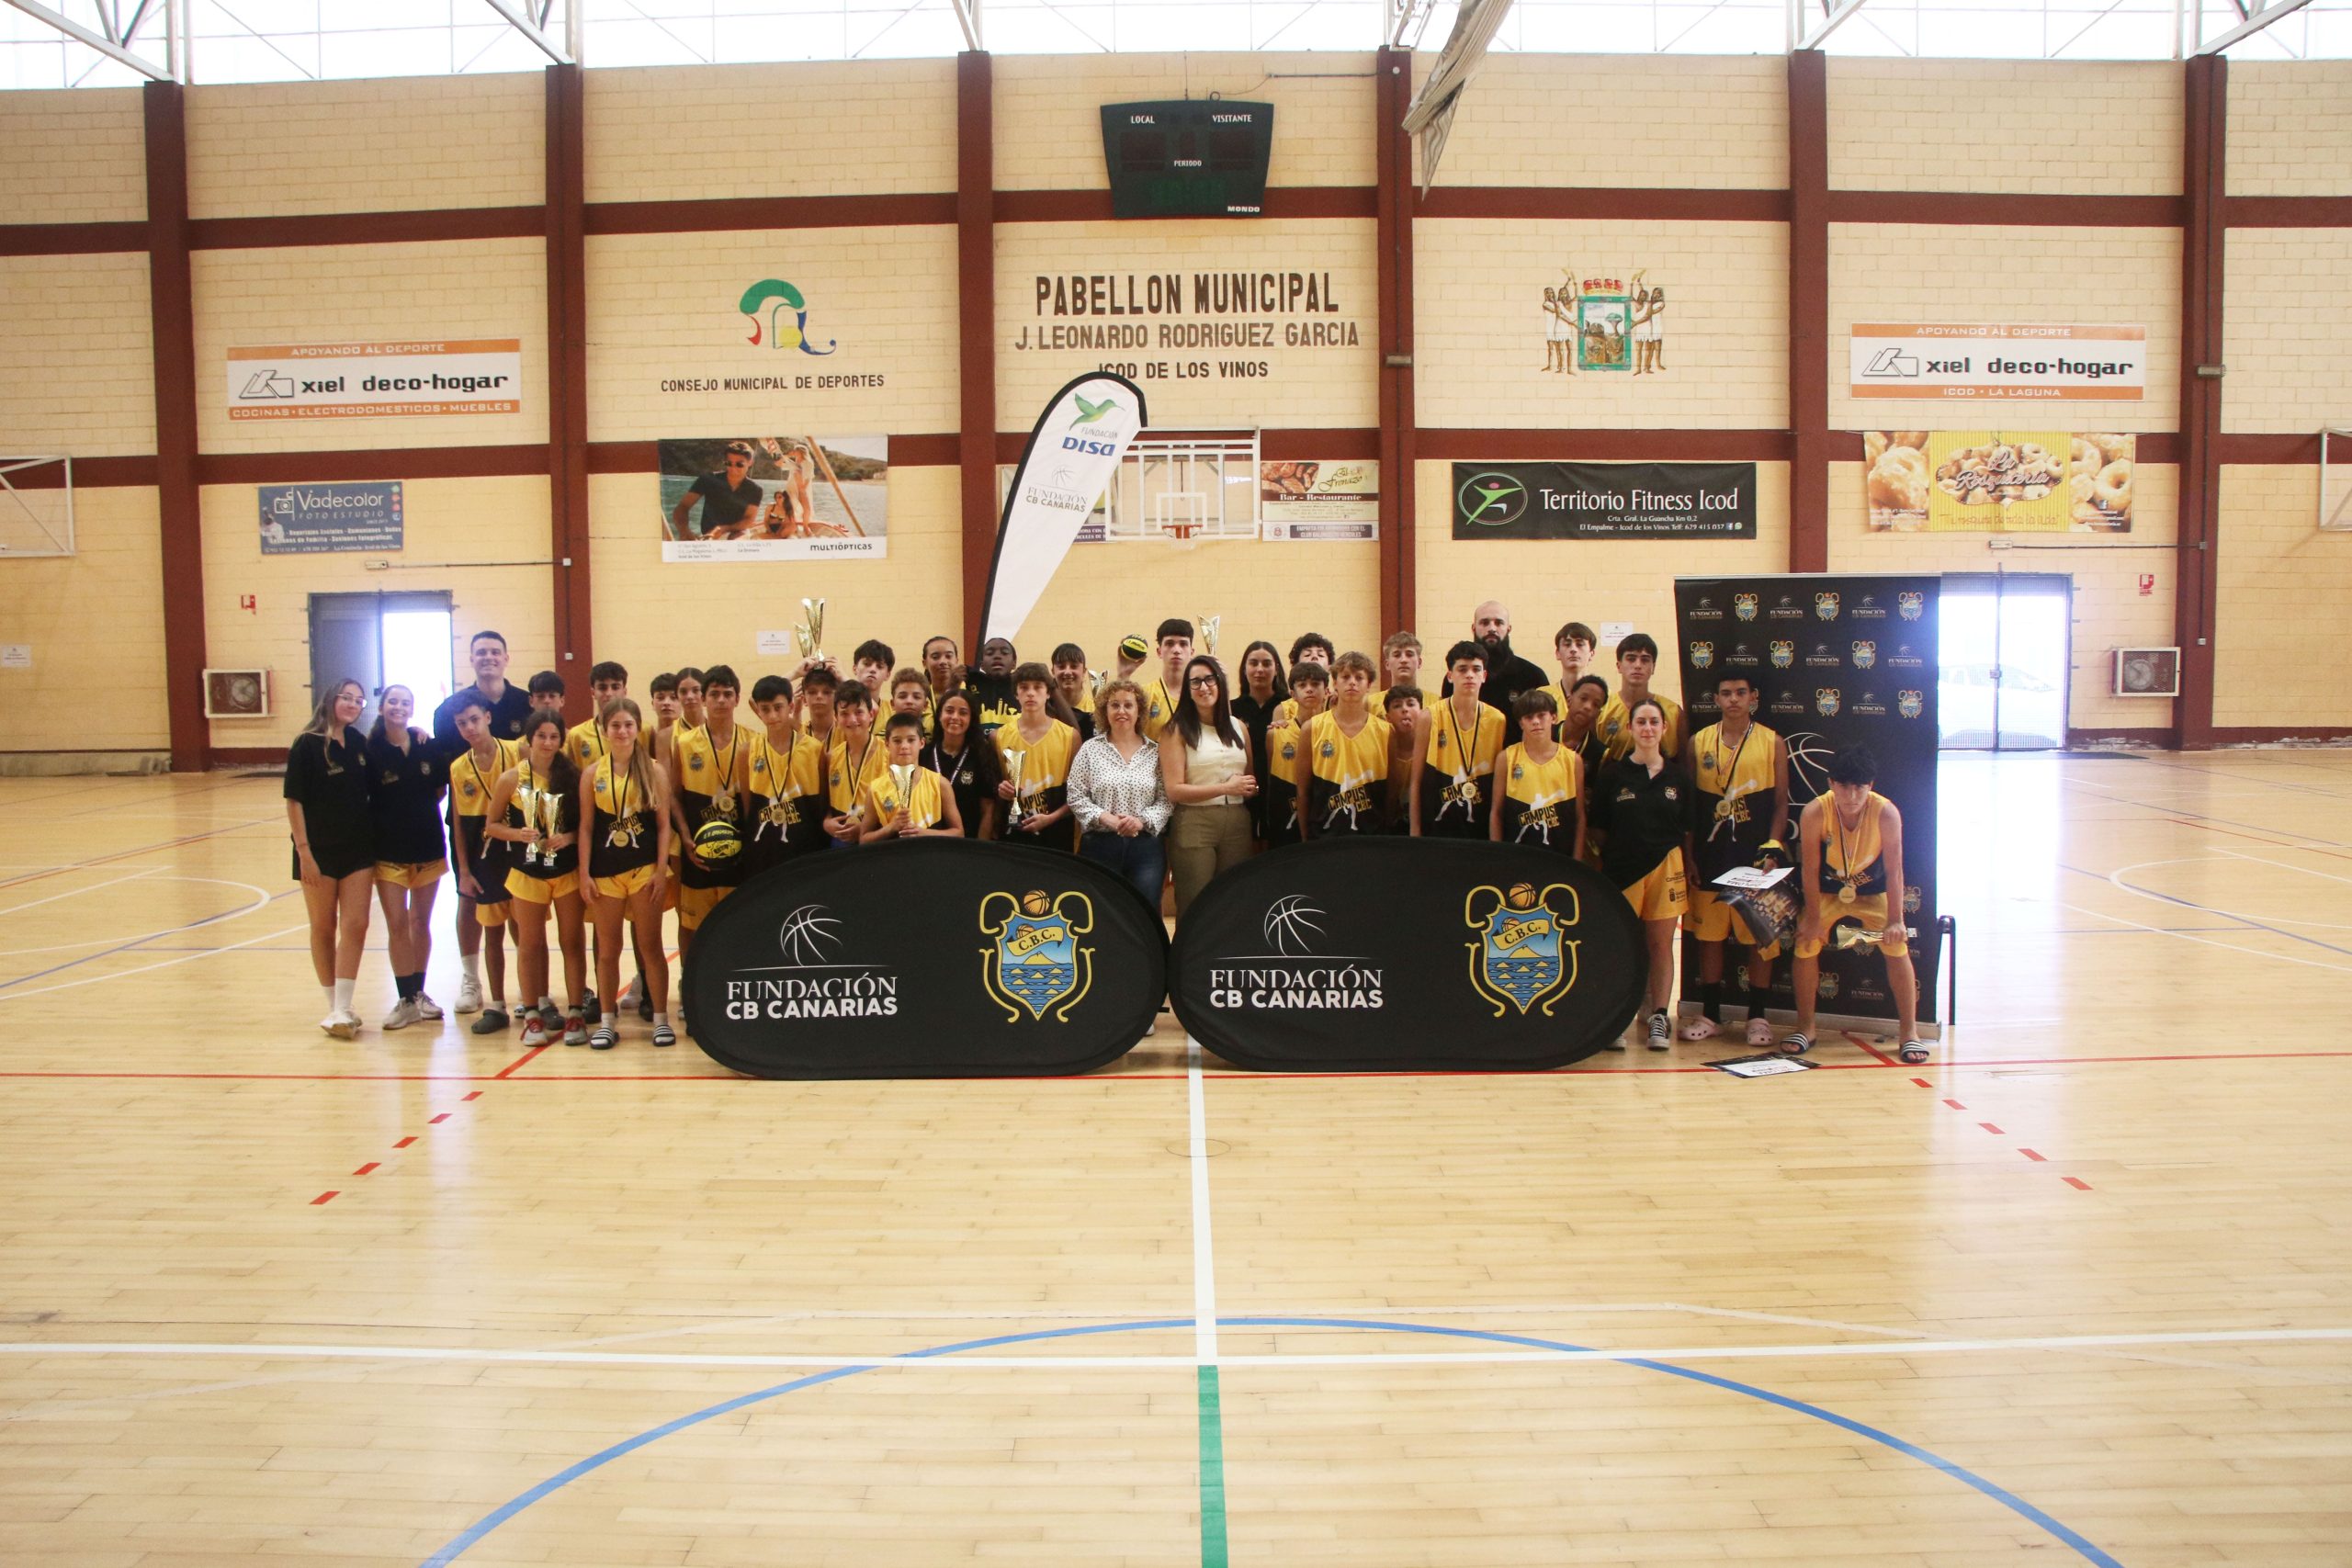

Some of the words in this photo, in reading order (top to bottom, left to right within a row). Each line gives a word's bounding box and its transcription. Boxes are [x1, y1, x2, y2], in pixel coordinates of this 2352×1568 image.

[1130, 115, 1155, 124] LOCAL
[1212, 114, 1252, 123] VISITANTE
[1036, 274, 1182, 316] PABELLON
[1194, 272, 1339, 314] MUNICIPAL
[1038, 324, 1148, 349] LEONARDO
[1159, 322, 1274, 348] RODRIGUEZ
[1285, 321, 1359, 346] GARCIA
[1917, 327, 1987, 336] APOYANDO
[1992, 328, 2007, 336] AL
[2012, 328, 2071, 337] DEPORTE
[291, 345, 360, 356] APOYANDO
[367, 345, 381, 355] AL
[386, 344, 445, 354] DEPORTE
[1099, 363, 1137, 379] ICOD
[1146, 362, 1168, 378] DE
[1176, 362, 1209, 378] LOS
[1218, 361, 1268, 378] VINOS
[1927, 357, 1970, 373] xiel
[1987, 357, 2133, 378] deco-hogar
[301, 376, 345, 393] xiel
[362, 373, 509, 392] deco-hogar
[661, 378, 718, 392] CONSEJO
[724, 377, 788, 391] MUNICIPAL
[795, 376, 812, 389] DE
[818, 375, 885, 389] DEPORTES
[1943, 388, 1975, 396] ICOD
[2008, 389, 2061, 397] LAGUNA
[232, 408, 290, 418] COCINAS
[298, 404, 441, 416] ELECTRODOMESTICOS
[450, 401, 512, 412] MUEBLES
[297, 490, 384, 511] Vadecolor
[1026, 494, 1038, 504] CB
[1041, 499, 1086, 513] CANARIAS
[1540, 489, 1624, 511] Territorio
[1632, 489, 1692, 511] Fitness
[1700, 488, 1738, 510] Icod
[334, 510, 385, 519] ESTUDIO
[1017, 928, 1056, 952] C.B.C.
[1503, 921, 1542, 944] C.B.C.
[727, 972, 898, 1000] FUNDACIÓN
[1210, 964, 1383, 988] FUNDACIÓN
[726, 999, 760, 1021] CB
[767, 996, 898, 1019] CANARIAS
[1210, 989, 1243, 1009] CB
[1251, 988, 1384, 1009] CANARIAS
